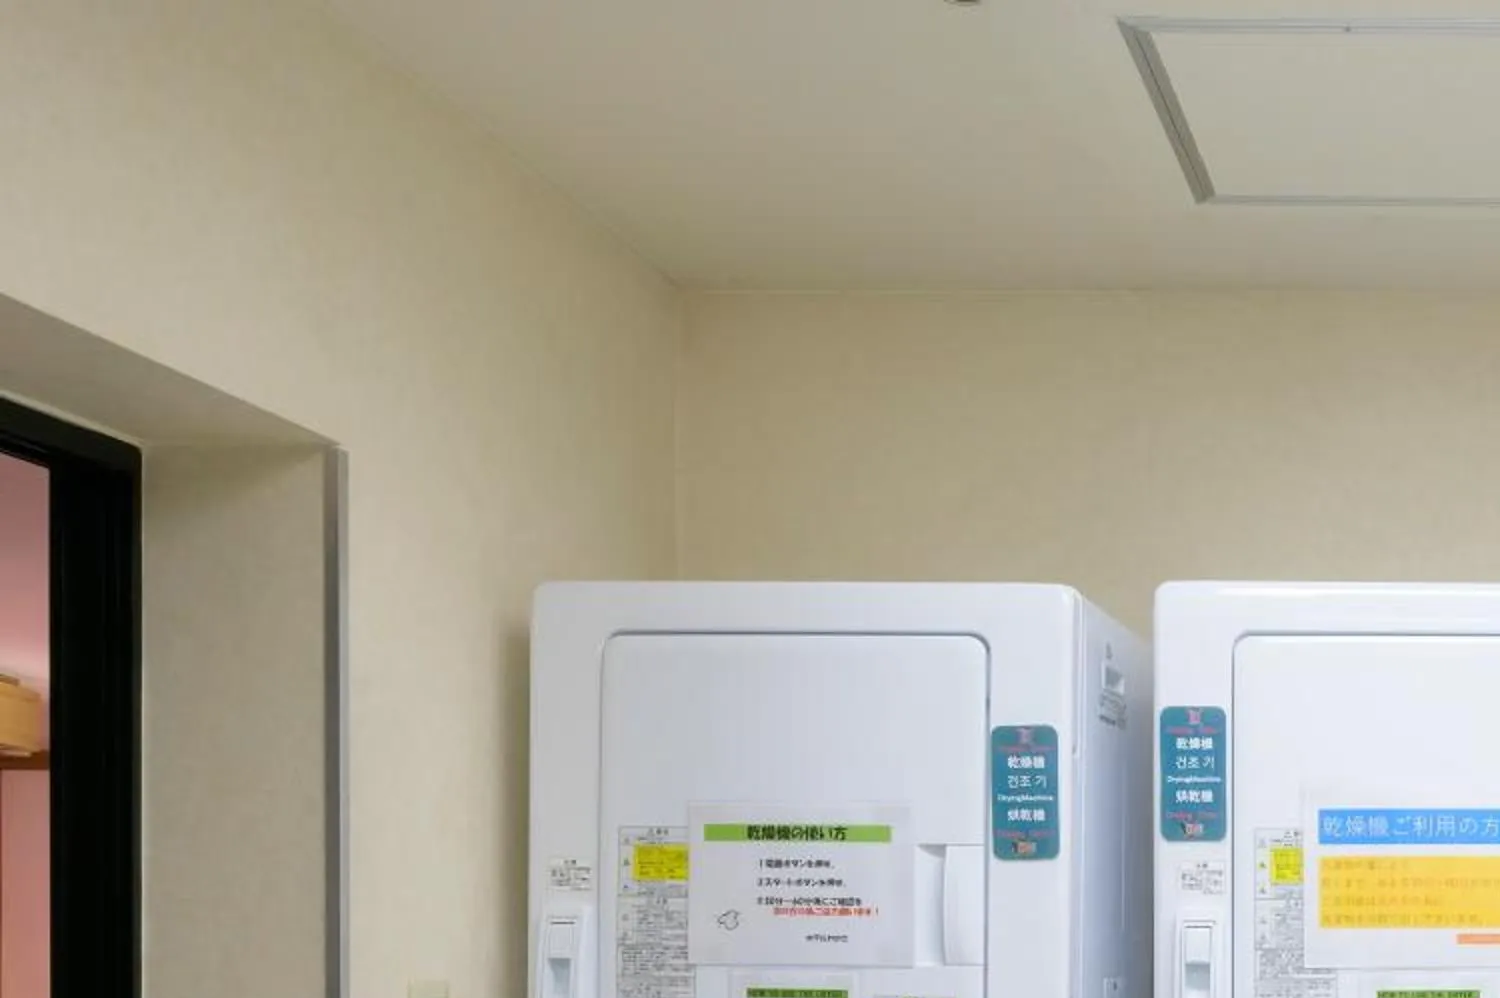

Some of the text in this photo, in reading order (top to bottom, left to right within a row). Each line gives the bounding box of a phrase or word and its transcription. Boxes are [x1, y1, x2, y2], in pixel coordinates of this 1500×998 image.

[747, 824, 849, 841] 乾燥機の使い方
